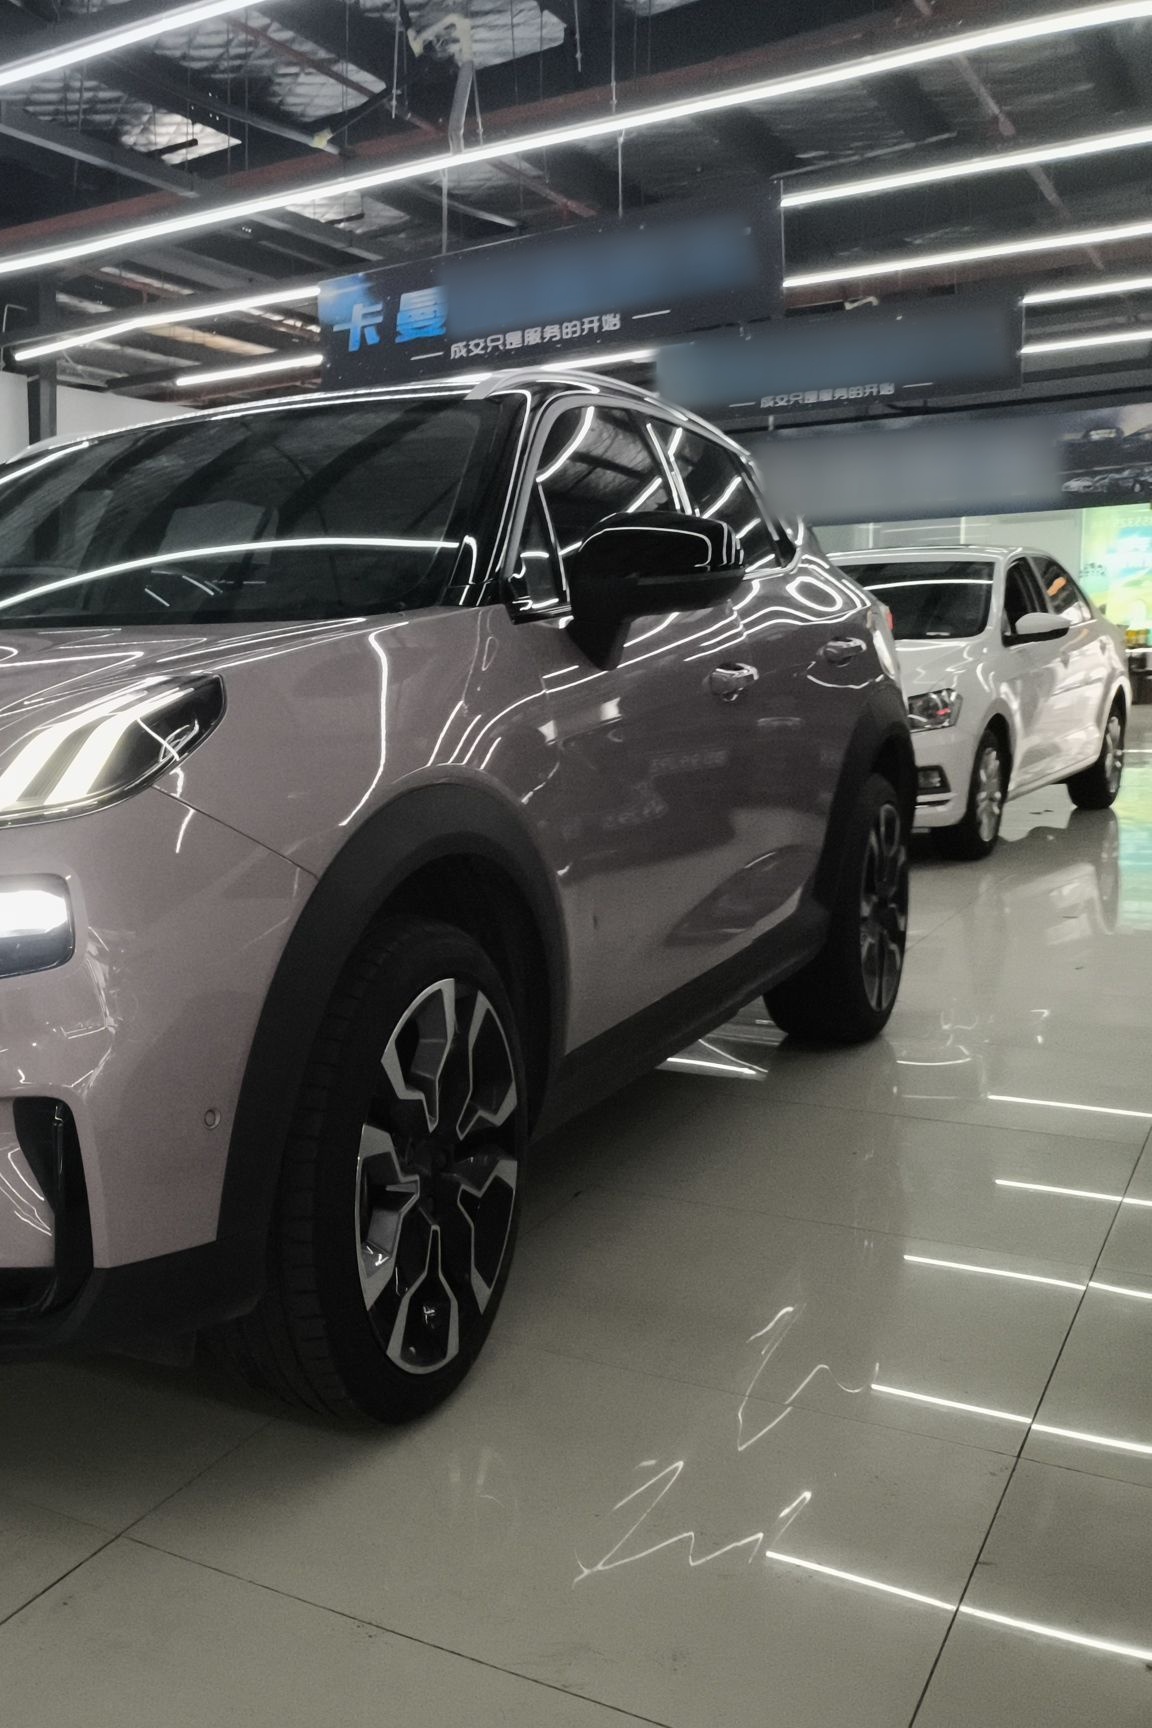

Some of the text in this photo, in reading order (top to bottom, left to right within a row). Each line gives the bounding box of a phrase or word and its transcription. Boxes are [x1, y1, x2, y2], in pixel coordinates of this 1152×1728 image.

[450, 313, 620, 359] 成交只是服务的开始
[760, 382, 895, 408] 成交只是服务的开始
